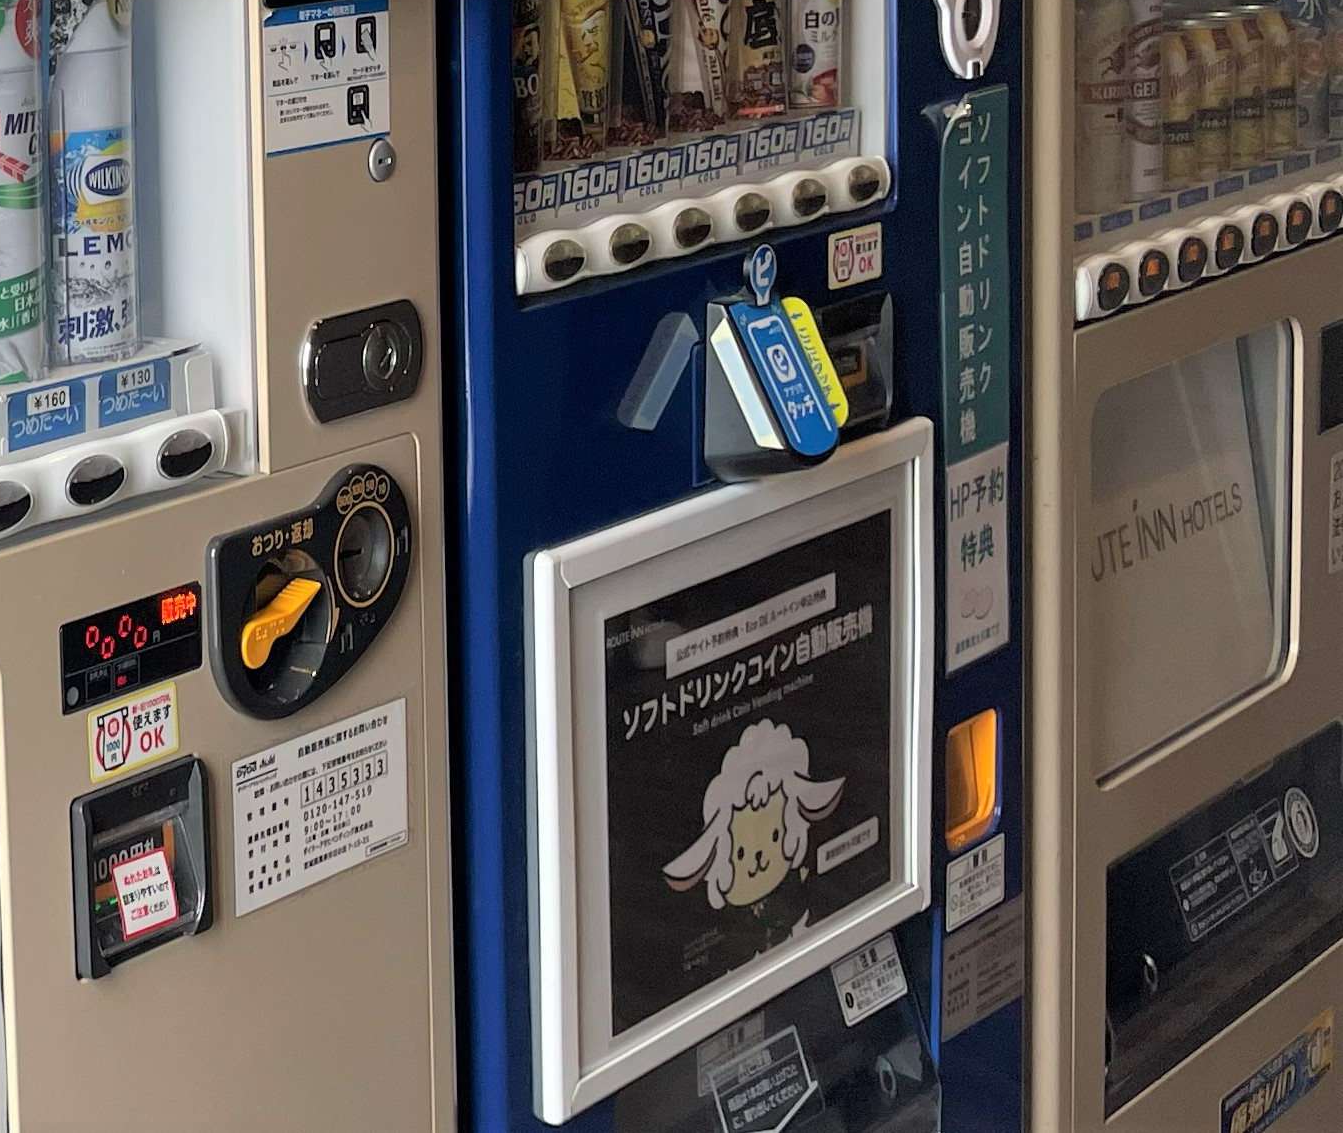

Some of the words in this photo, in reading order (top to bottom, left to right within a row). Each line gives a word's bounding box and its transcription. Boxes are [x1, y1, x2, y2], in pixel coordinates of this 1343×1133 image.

[804, 118, 851, 151] 160円
[687, 140, 738, 173] 160円
[563, 164, 619, 204] 160円
[859, 255, 873, 273] OK
[976, 109, 992, 394] ソフトドリンク
[956, 117, 977, 445] コイン自動販売機
[121, 369, 151, 387] ¥130
[33, 391, 67, 410] ¥160
[787, 394, 815, 418] タッチ
[949, 469, 1005, 522] HP予約
[1181, 481, 1244, 541] HOTELS
[252, 517, 313, 557] おつり・返却
[960, 528, 996, 573] 特典
[623, 603, 873, 740] ソフトドリンクコイン自動販売機
[133, 704, 172, 731] 使えます
[106, 739, 120, 751] 1000
[139, 725, 165, 753] OK
[236, 761, 257, 779] DyDo
